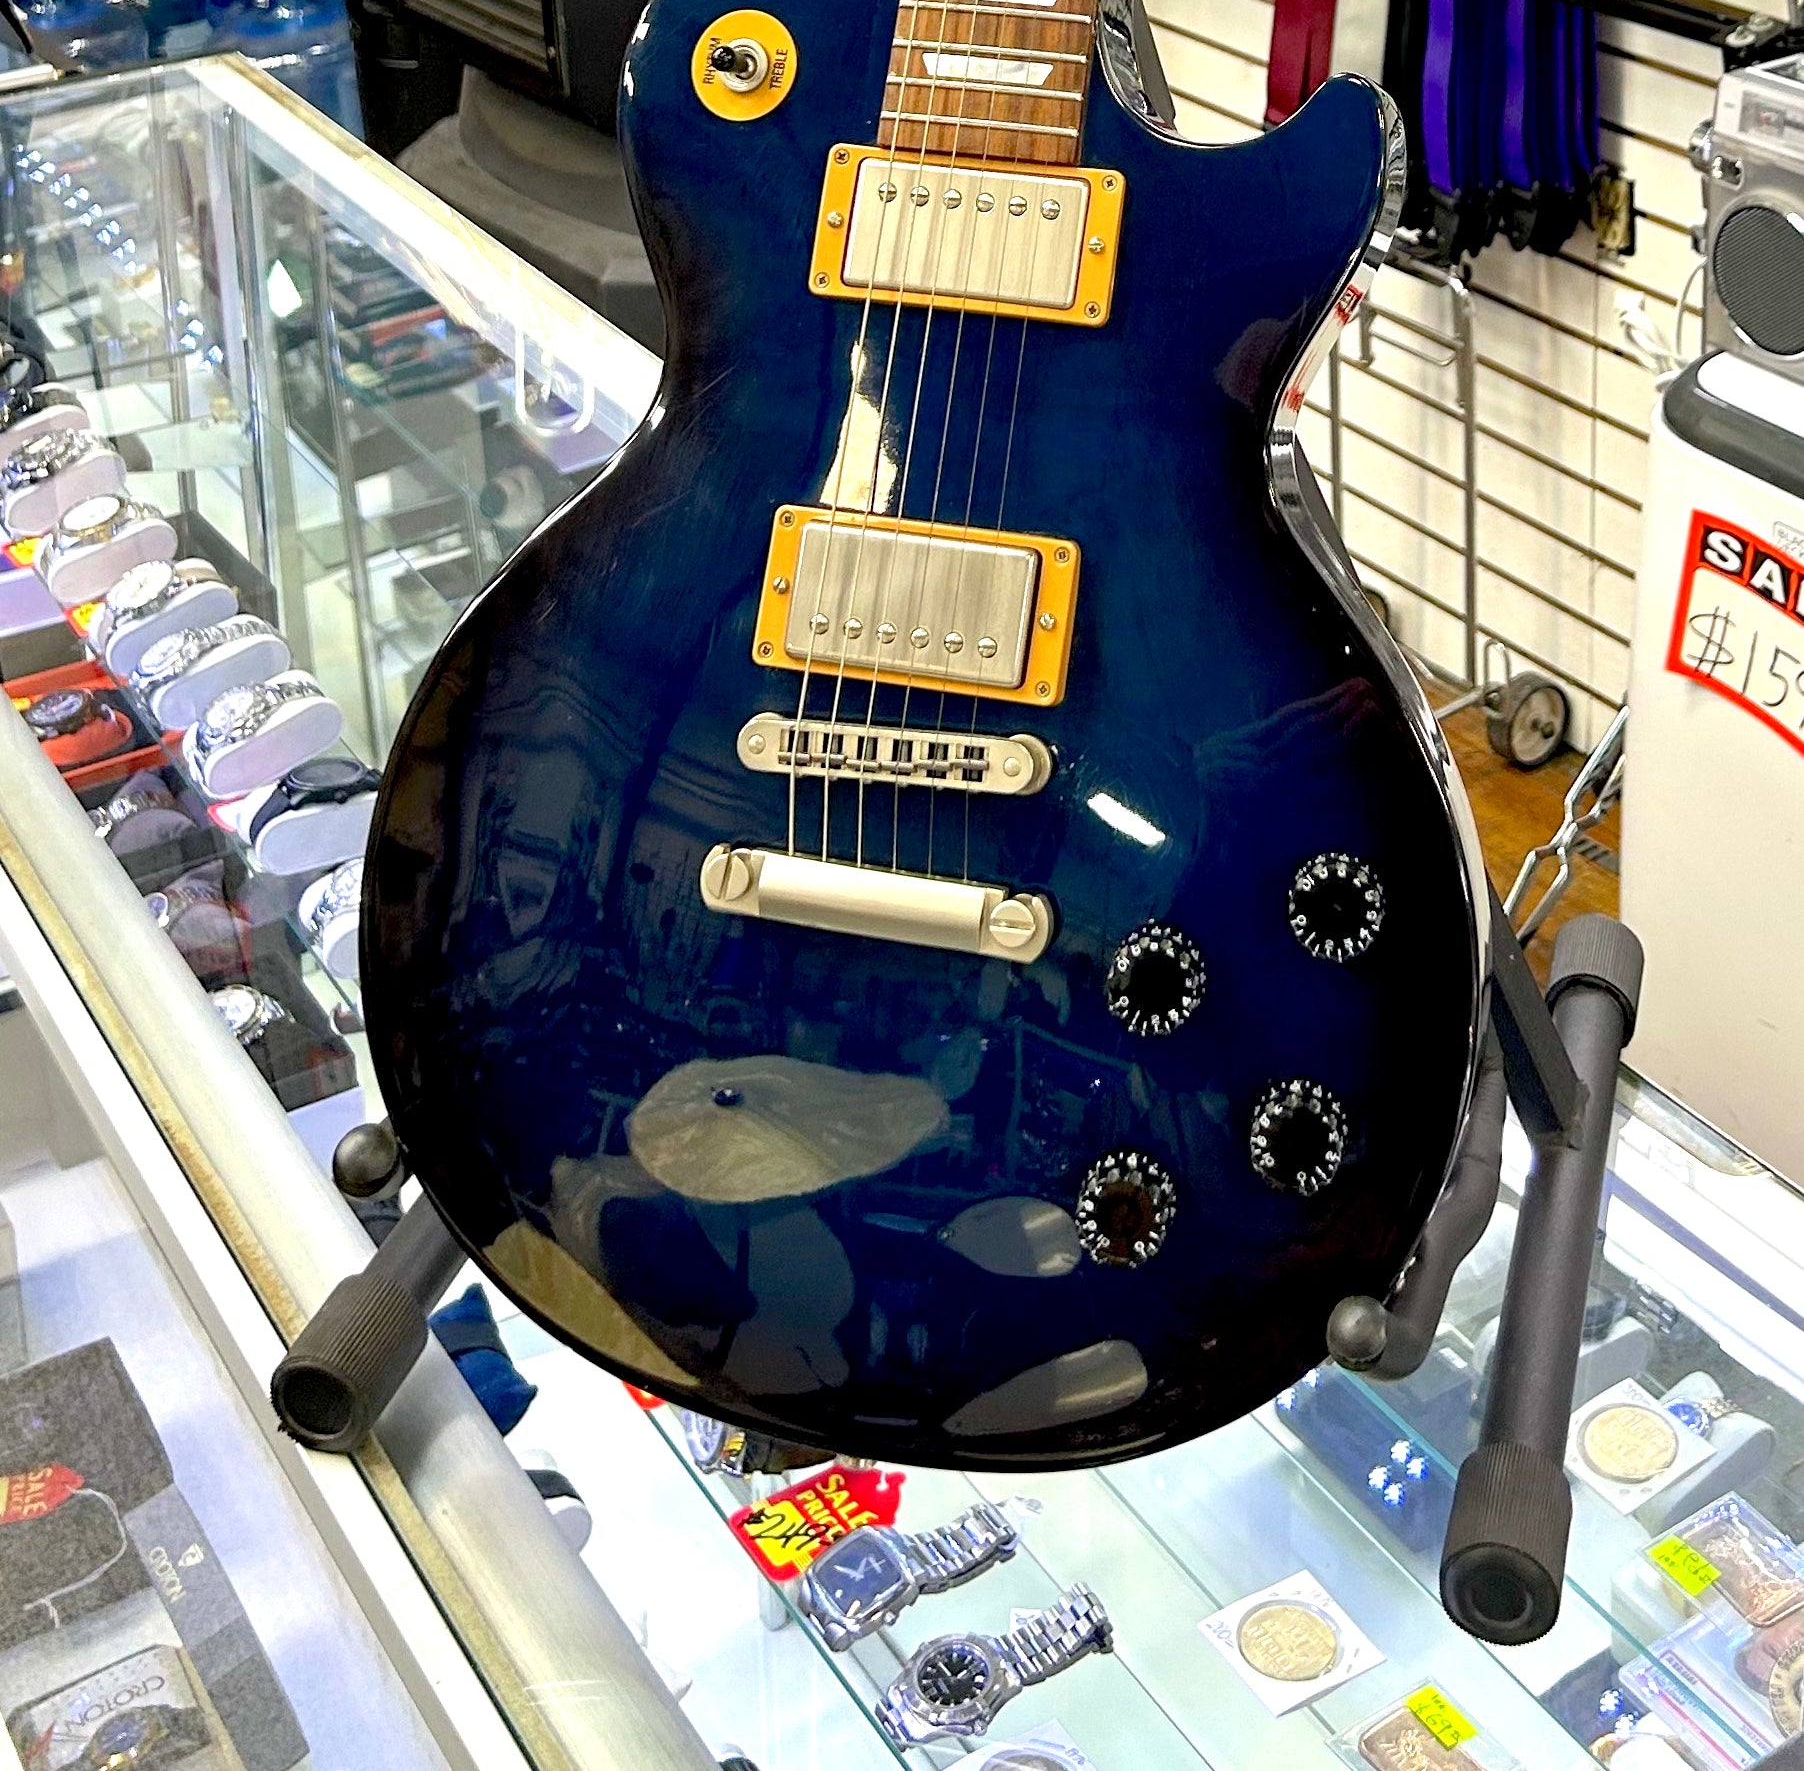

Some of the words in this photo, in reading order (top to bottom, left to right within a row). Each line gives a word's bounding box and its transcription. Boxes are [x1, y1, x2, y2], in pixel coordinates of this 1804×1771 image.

[702, 37, 722, 84] RHYM
[769, 48, 788, 90] TREBLE
[22, 1467, 53, 1517] SALE
[796, 1489, 846, 1543] PRICE
[815, 1473, 879, 1529] SALE
[64, 1675, 166, 1733] CROTON
